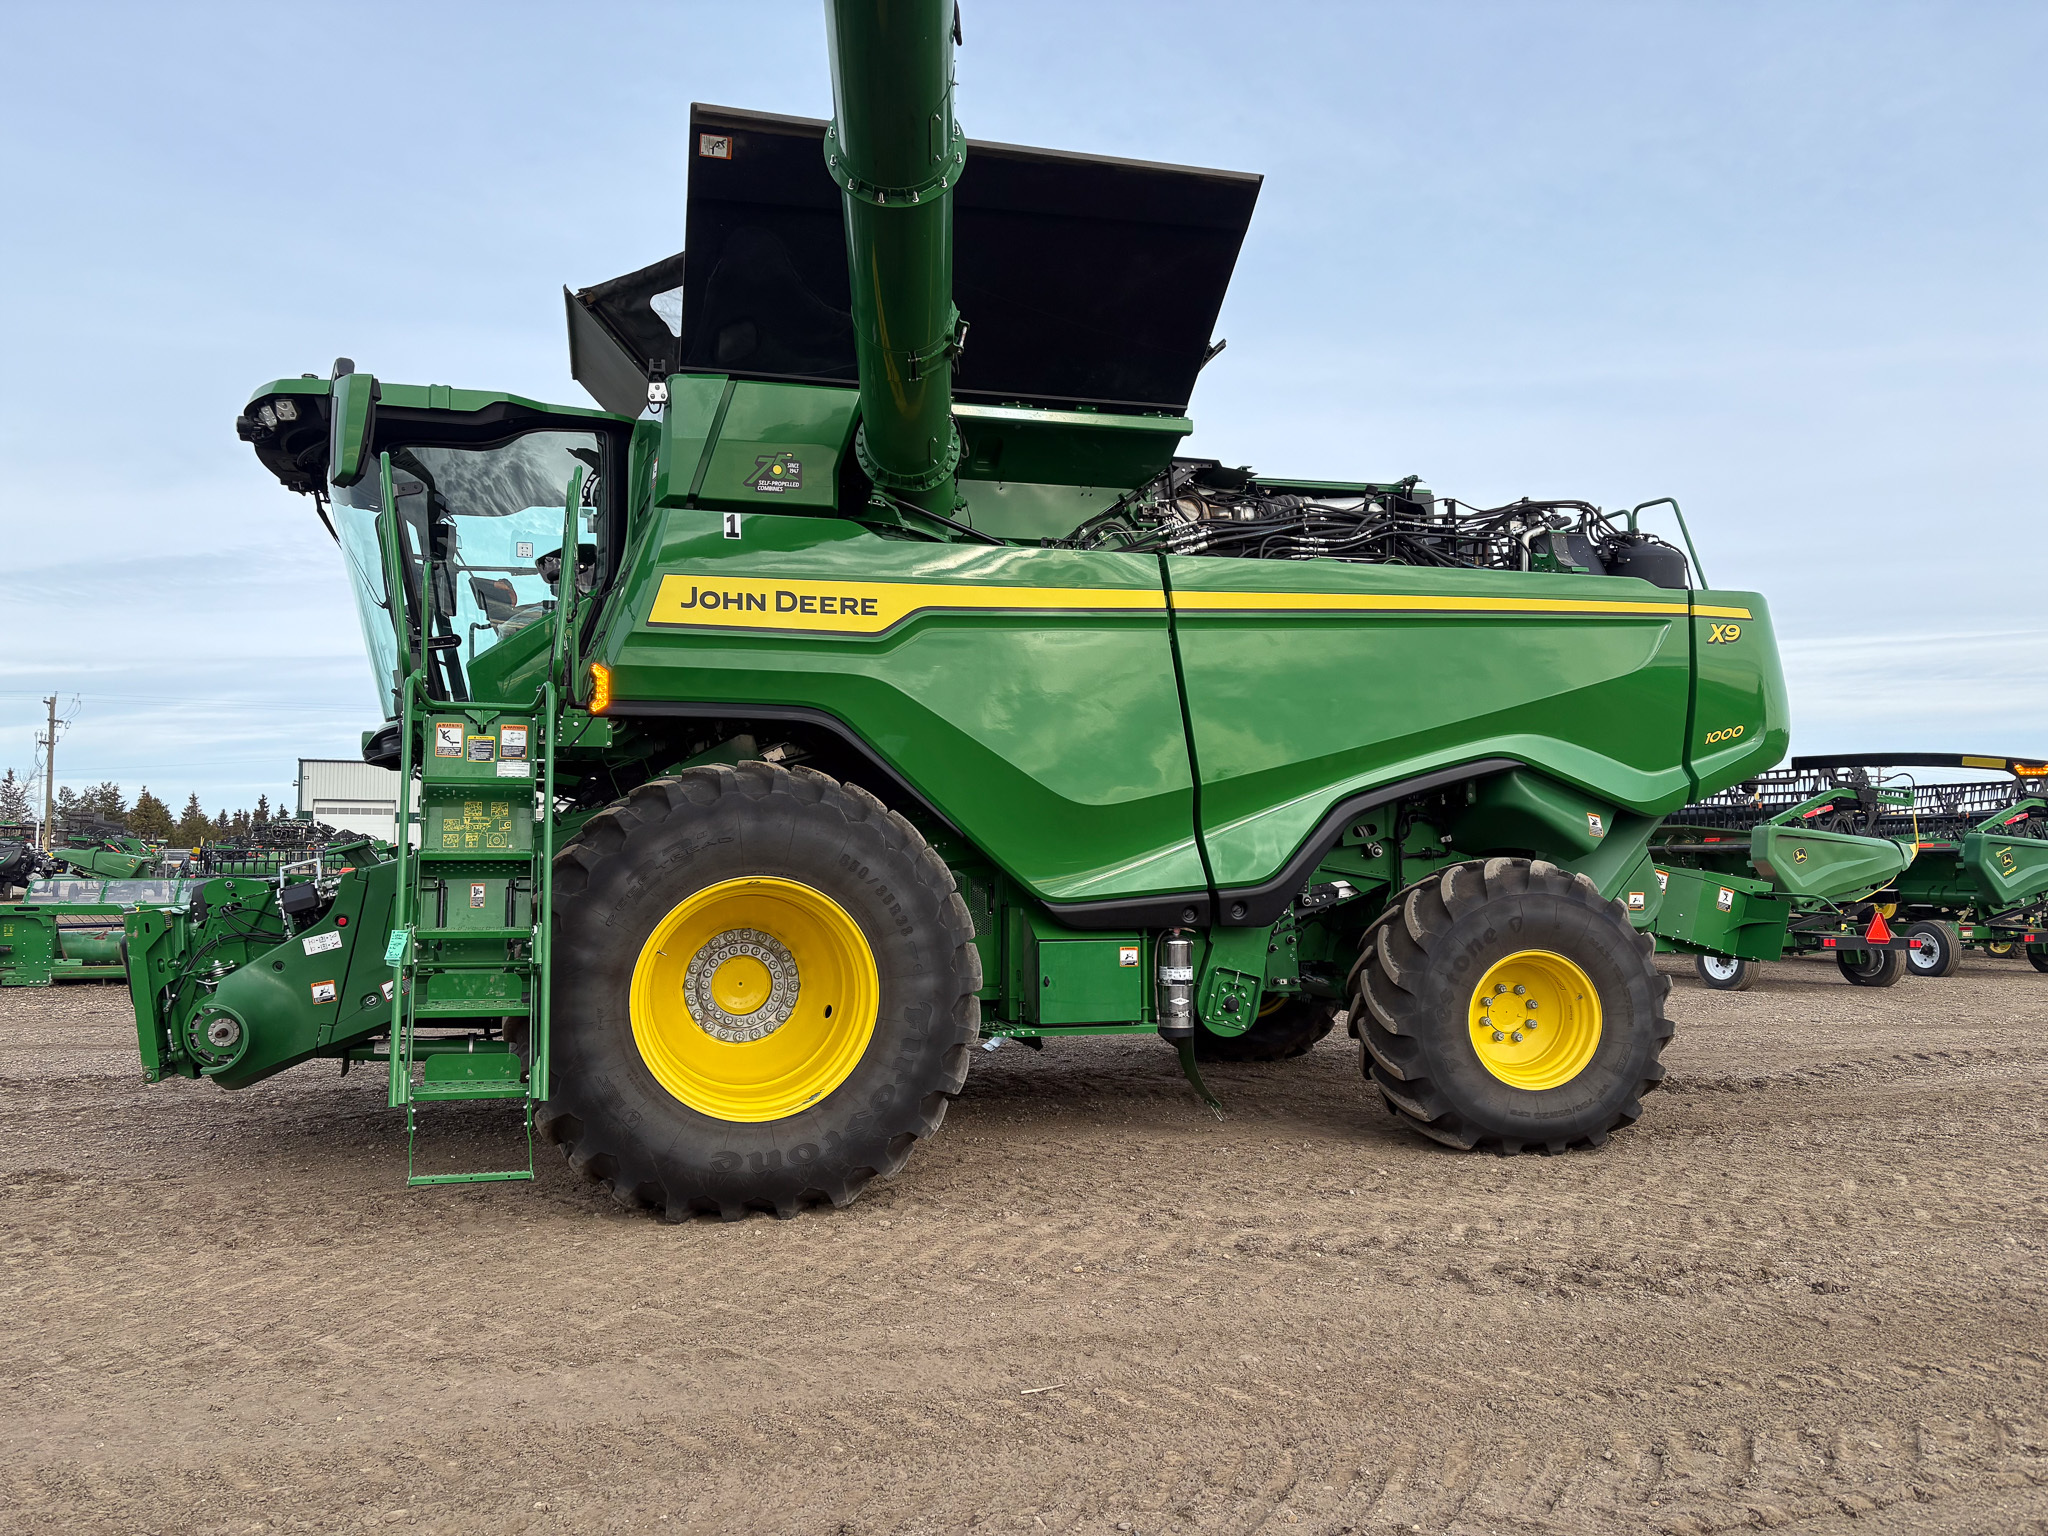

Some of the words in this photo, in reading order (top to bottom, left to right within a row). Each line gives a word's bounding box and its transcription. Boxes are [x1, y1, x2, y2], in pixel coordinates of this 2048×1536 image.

[758, 480, 799, 488] SELF-PROPELLED
[726, 514, 740, 538] 1
[681, 586, 766, 612] JOHN
[775, 590, 878, 616] DEERE
[1707, 623, 1742, 645] X9
[1704, 725, 1745, 745] 1000
[711, 1001, 933, 1174] Firestone
